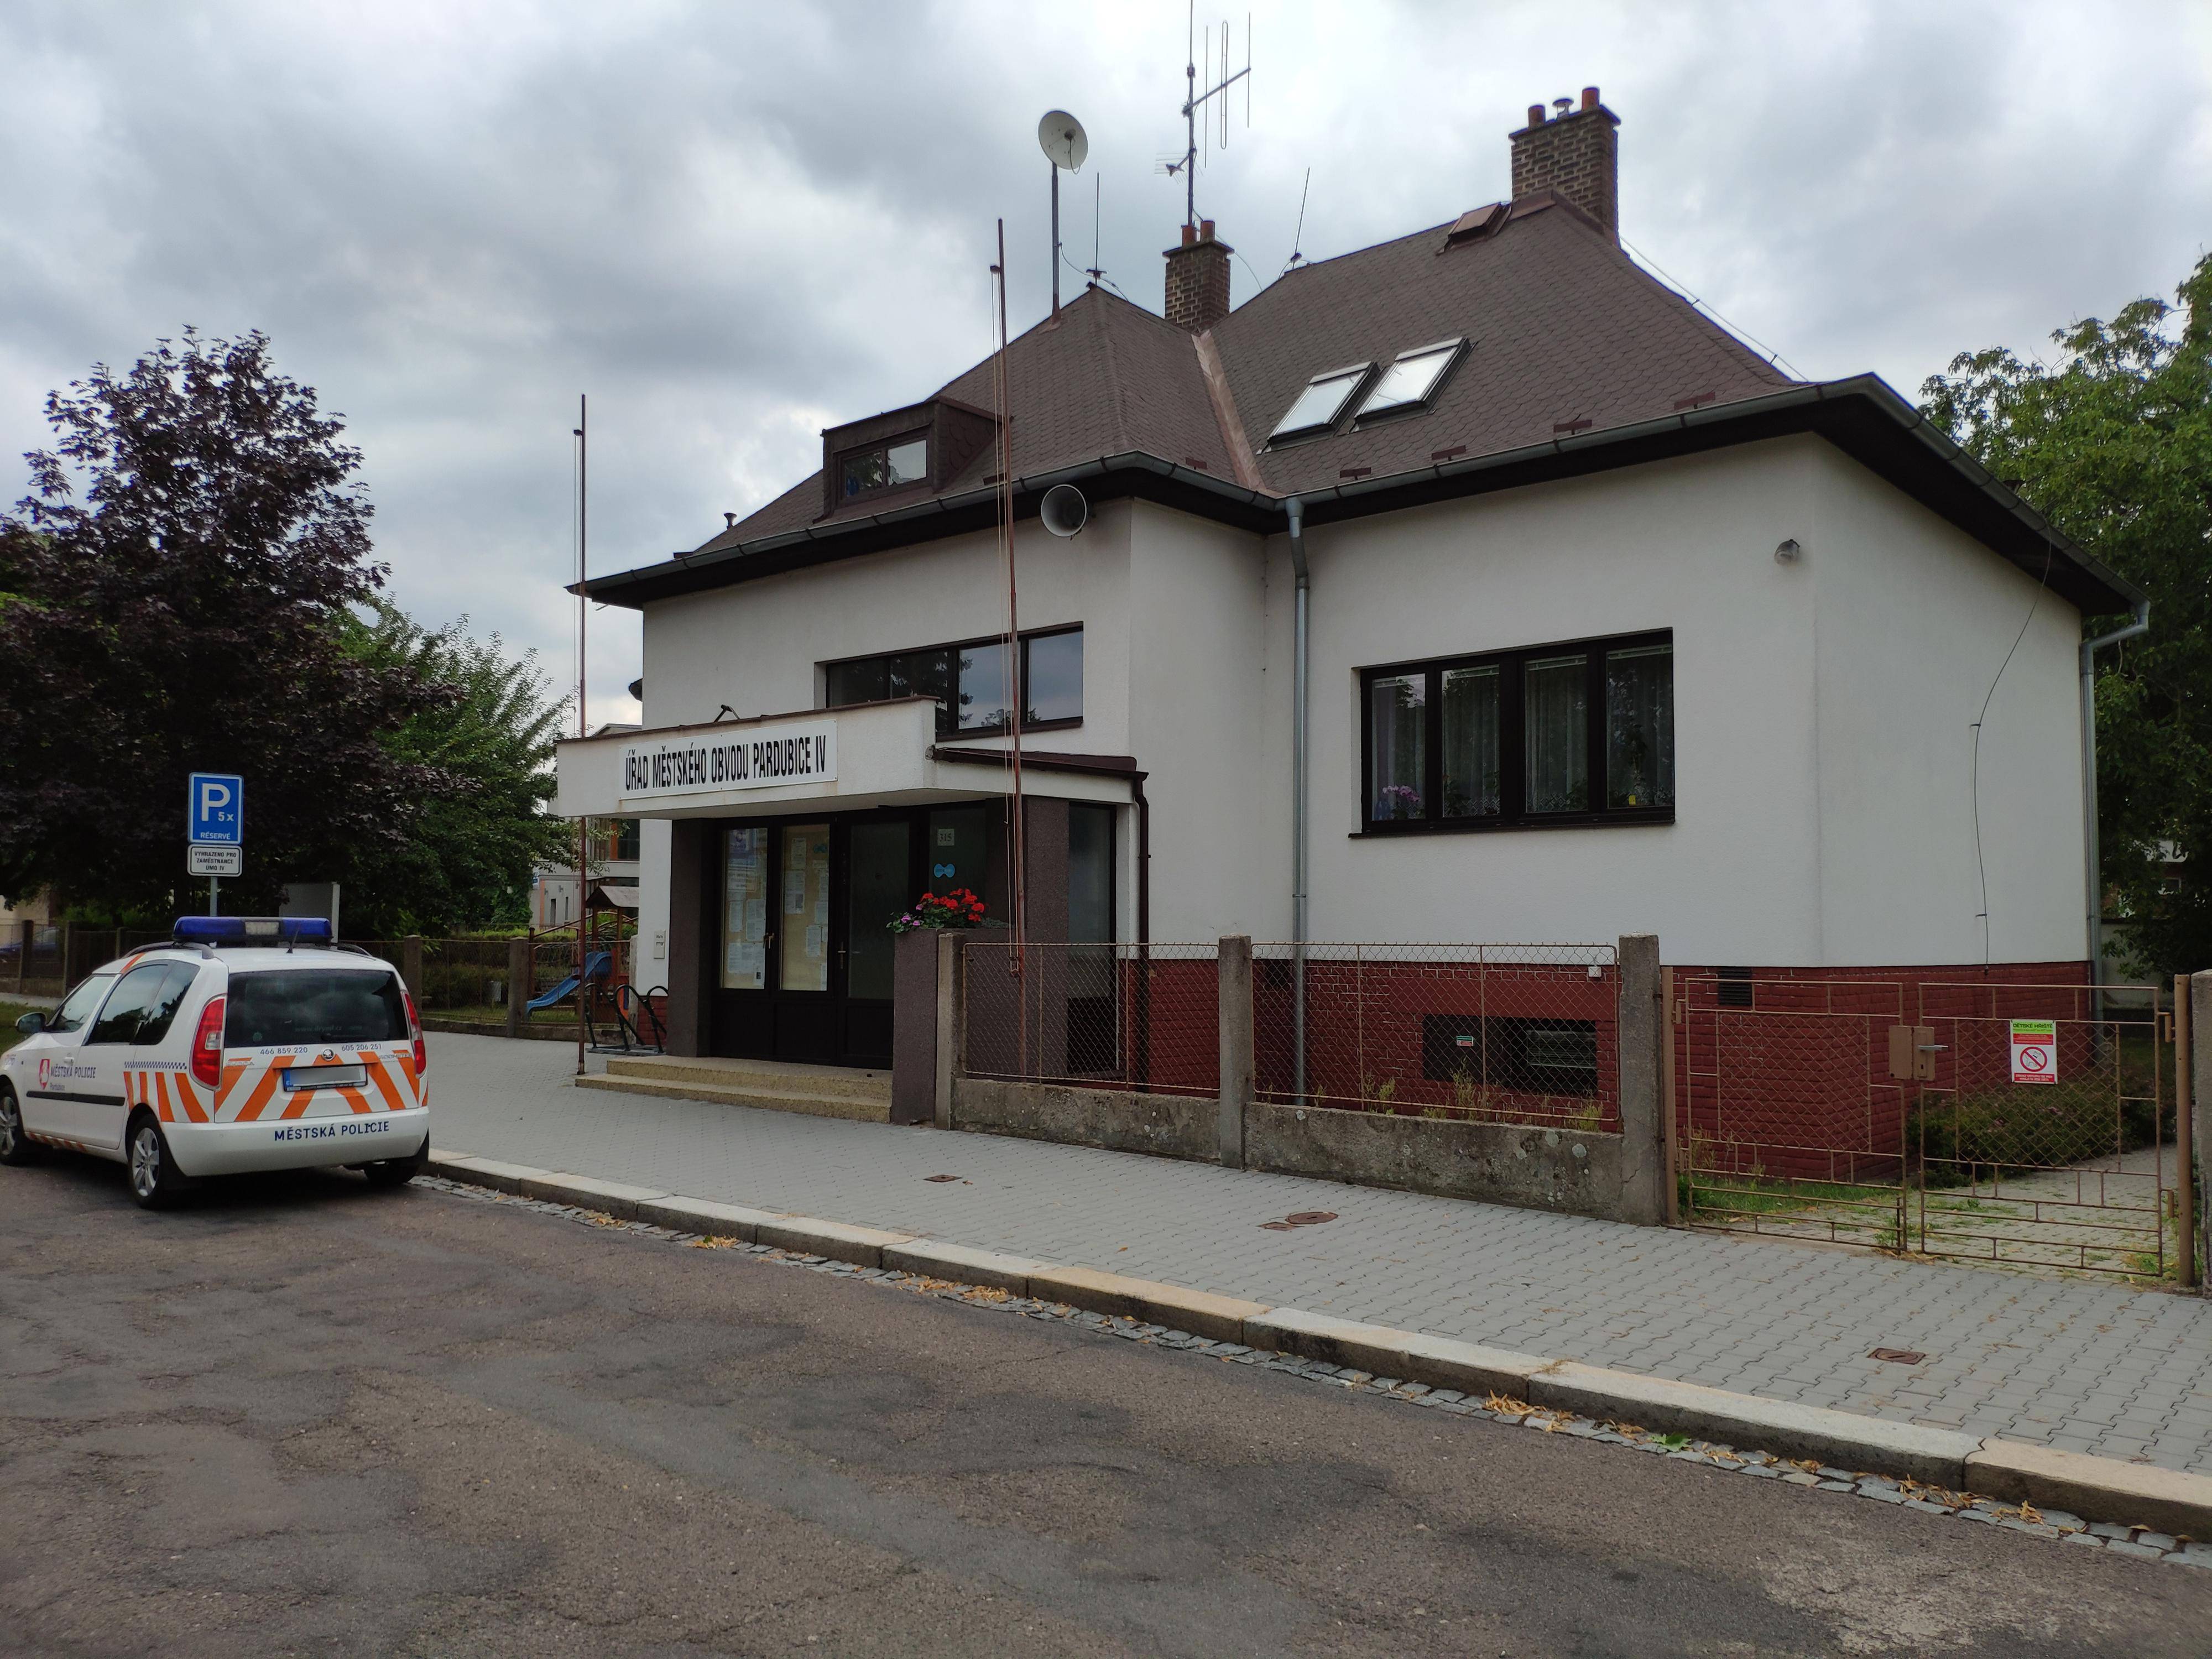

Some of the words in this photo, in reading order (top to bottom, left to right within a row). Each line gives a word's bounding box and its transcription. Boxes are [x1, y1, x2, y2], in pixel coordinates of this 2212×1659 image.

[625, 749, 649, 791] ÚŘAD
[653, 742, 707, 788] MĚSTSKÉHO
[711, 744, 749, 784] OBVODU
[753, 737, 811, 779] PARDUBICE
[816, 735, 826, 773] IV
[201, 783, 231, 822] P
[200, 831, 231, 839] RÉSERVÉ
[50, 1063, 72, 1077] MĚSTSKÁ
[74, 1067, 97, 1079] POLICIE
[274, 1123, 336, 1141] MĚSTSKÁ
[341, 1121, 390, 1136] POLICIE
